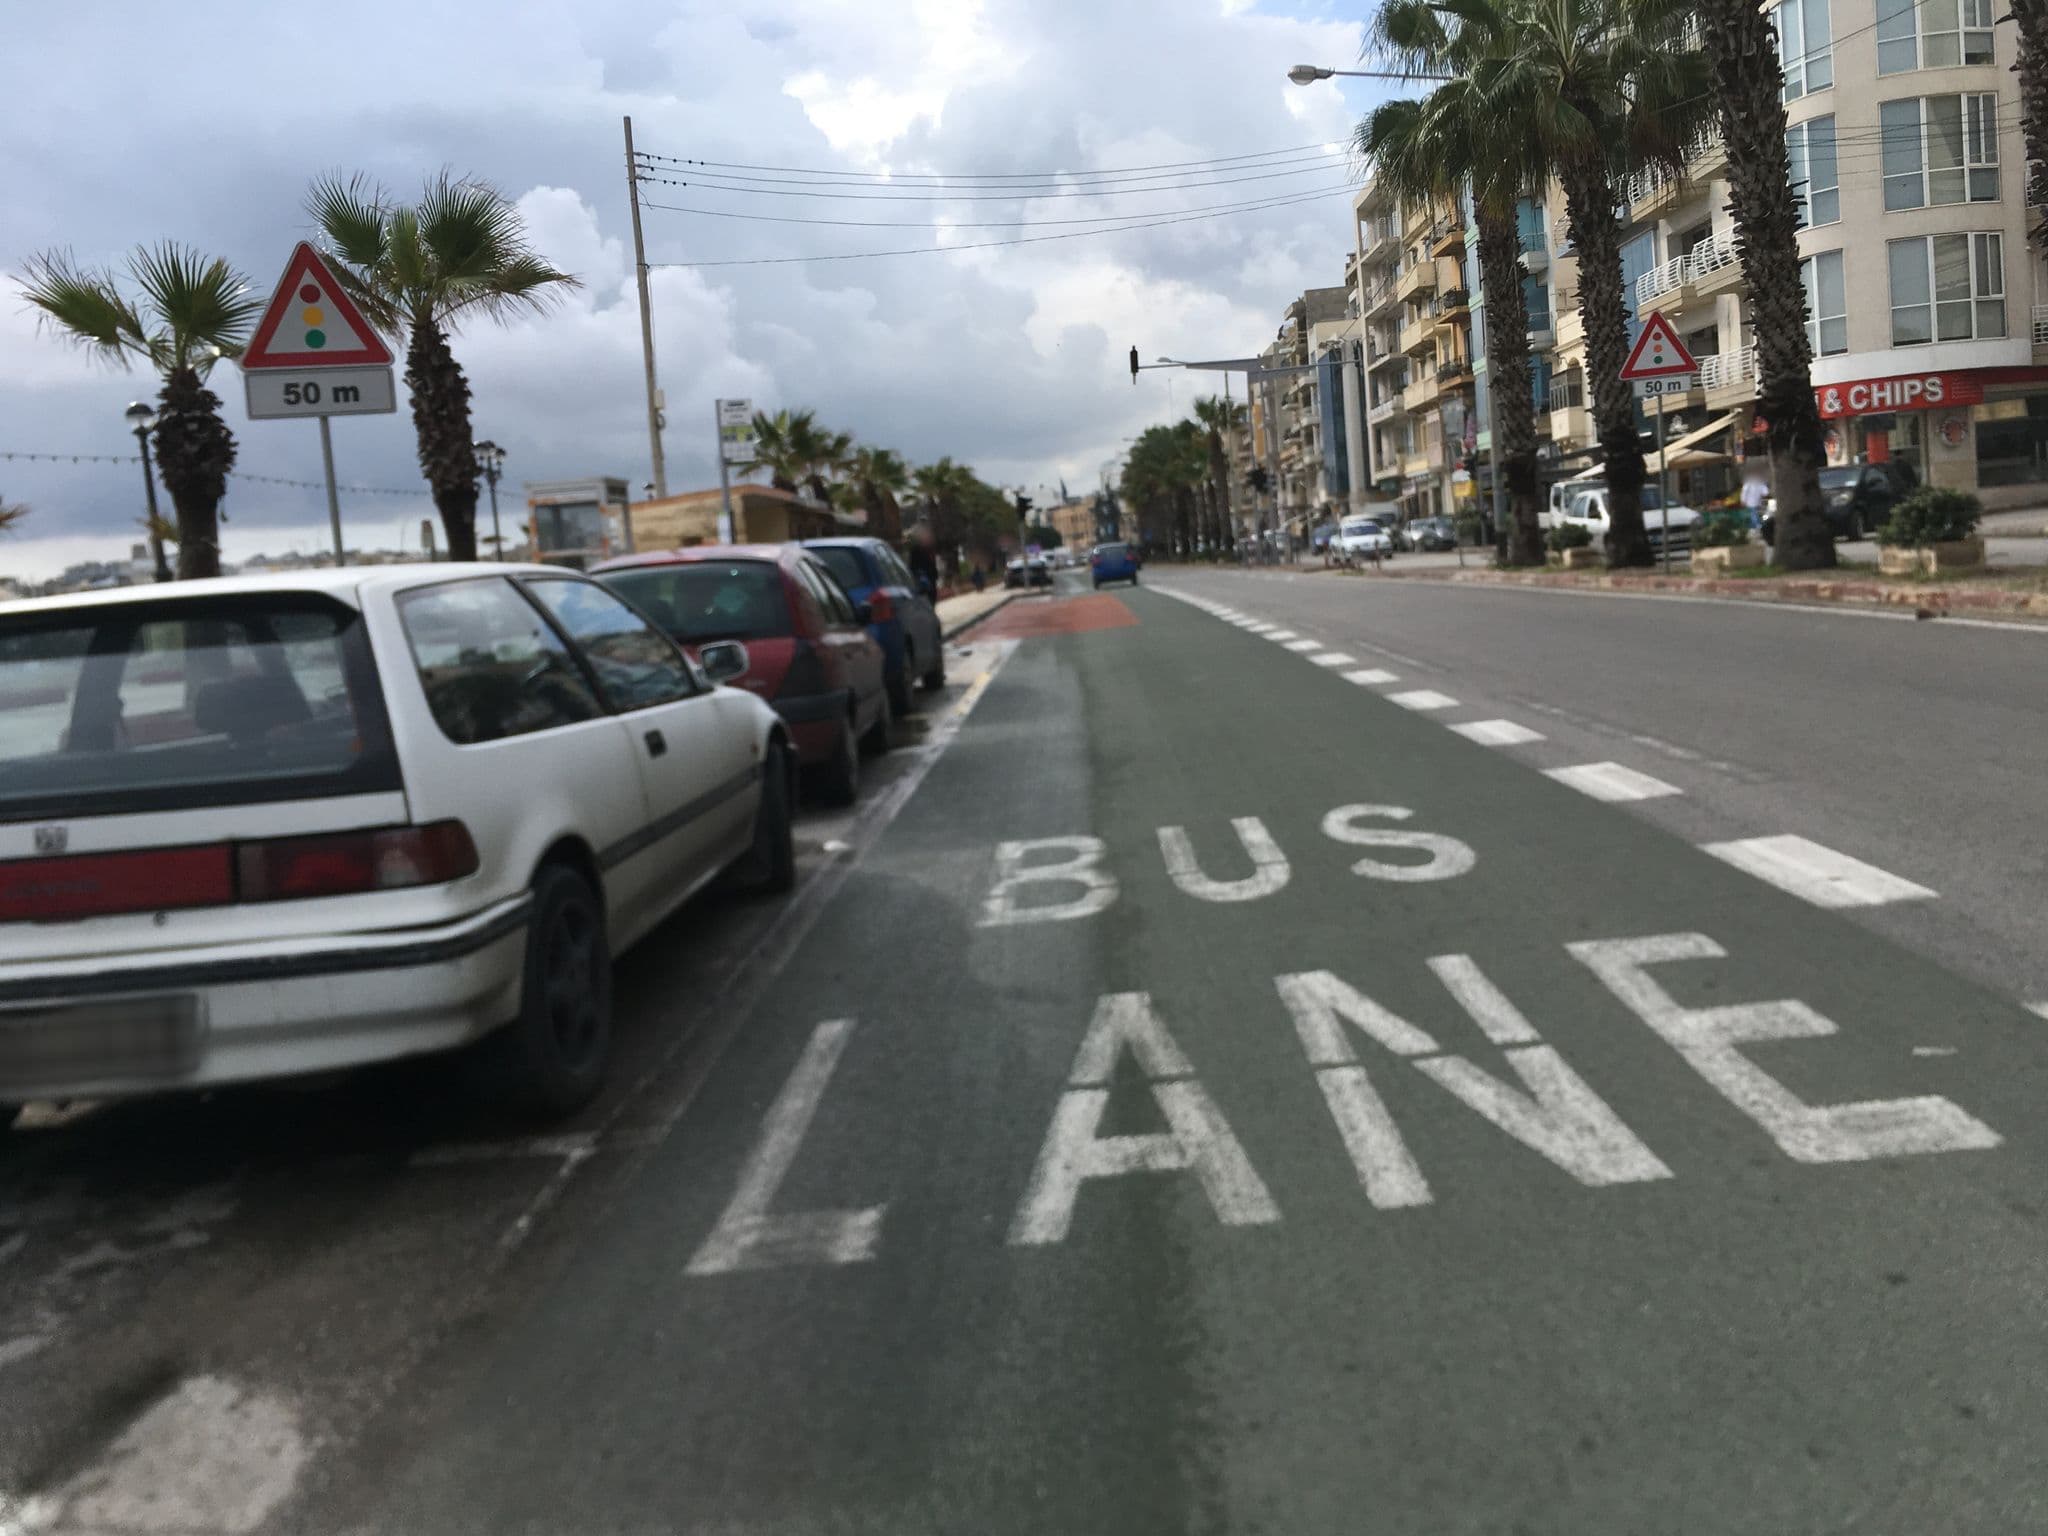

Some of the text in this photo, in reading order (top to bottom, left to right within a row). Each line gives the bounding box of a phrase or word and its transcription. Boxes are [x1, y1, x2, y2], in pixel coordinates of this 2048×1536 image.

[283, 382, 359, 405] 50 m
[1645, 381, 1681, 393] 50 m
[1824, 388, 1842, 413] &
[1850, 377, 1943, 409] CHIPS
[976, 803, 1477, 928] BUS
[684, 932, 2002, 1277] LANE
